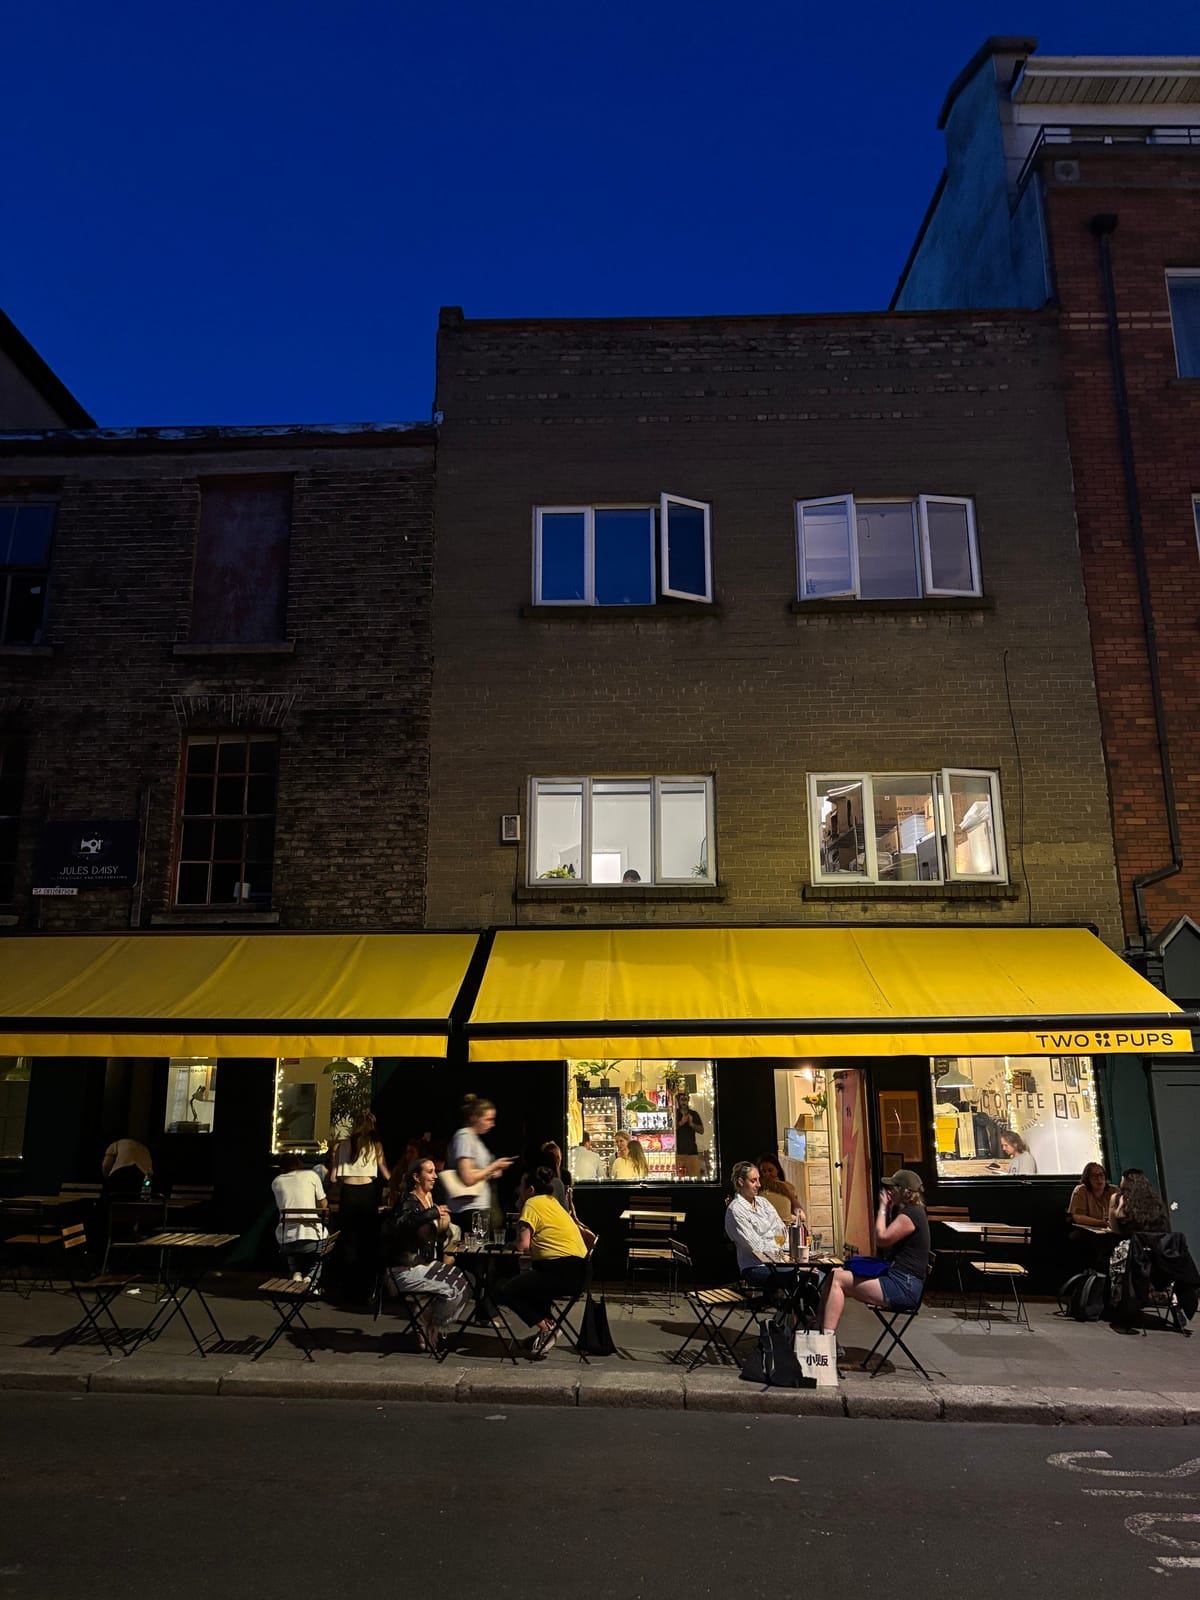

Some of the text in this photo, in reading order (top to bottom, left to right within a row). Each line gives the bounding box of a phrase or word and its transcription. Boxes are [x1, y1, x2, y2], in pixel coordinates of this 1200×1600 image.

[59, 865, 120, 876] JULES DAISY
[1036, 1033, 1173, 1048] TWO PUPS
[982, 1093, 1045, 1109] COFFEE
[806, 1354, 829, 1367] 小贩
